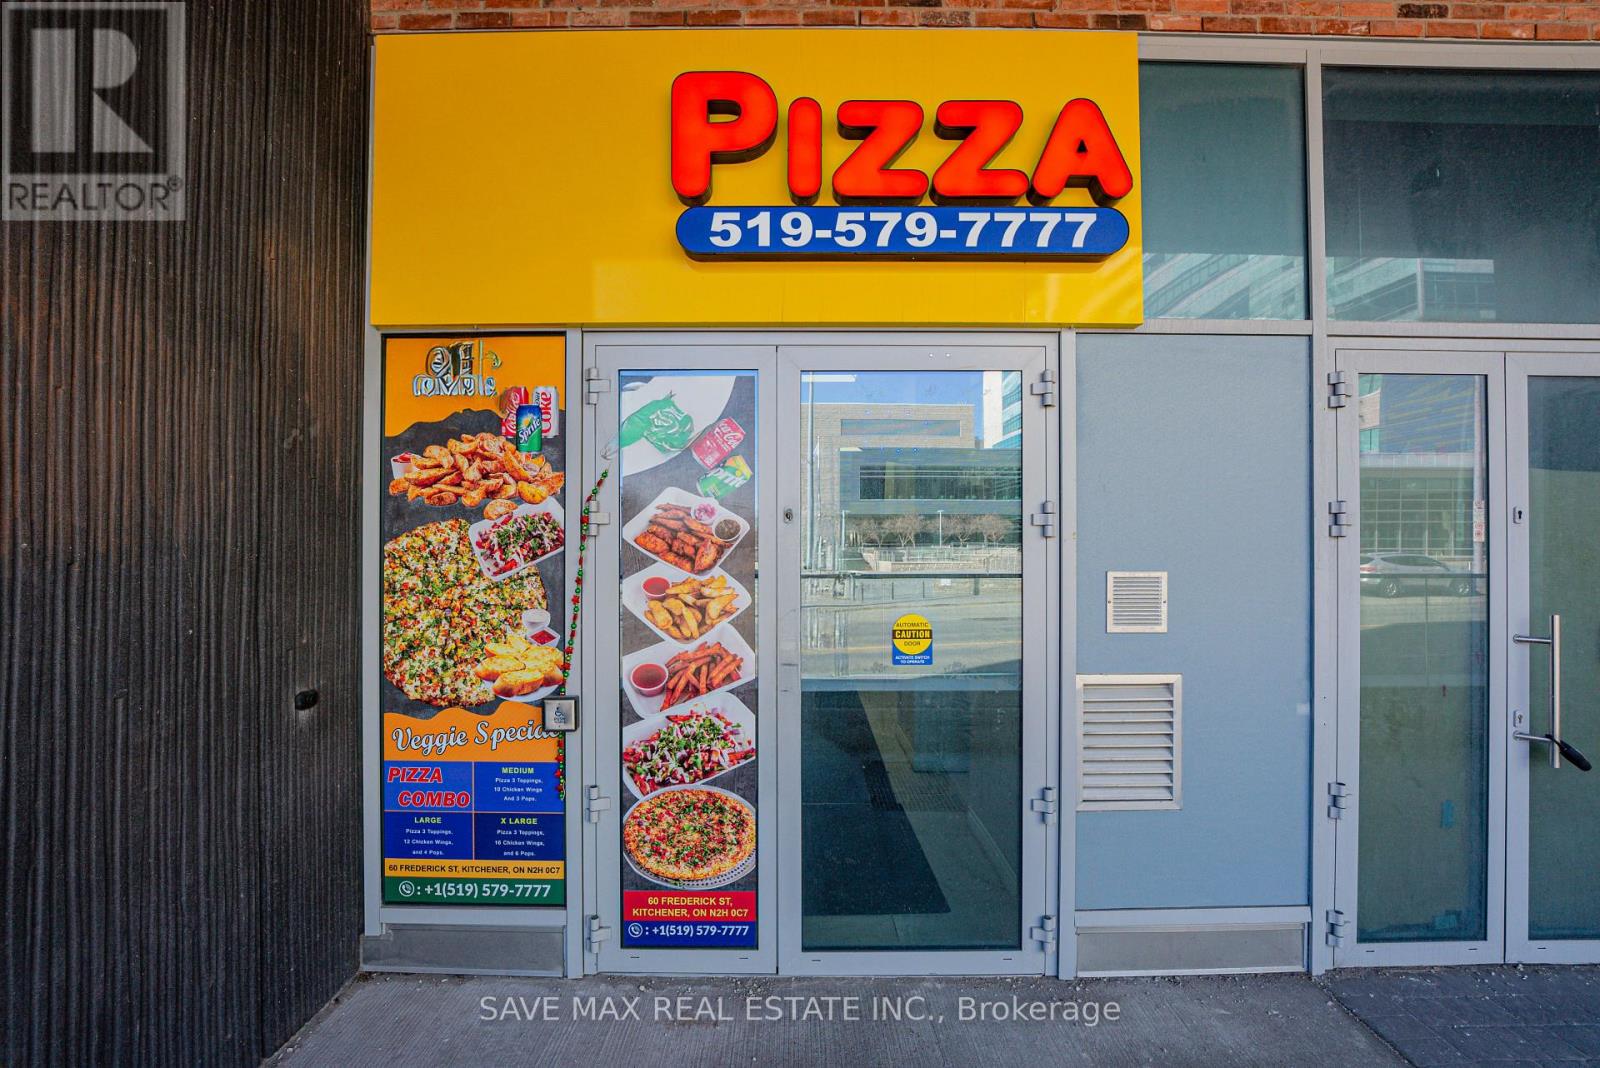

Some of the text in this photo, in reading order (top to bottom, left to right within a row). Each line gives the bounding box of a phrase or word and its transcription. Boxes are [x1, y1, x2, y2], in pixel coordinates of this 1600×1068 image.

[709, 212, 1097, 248] 519-579-7777
[518, 418, 541, 444] Sprite
[895, 630, 930, 639] CAUTION
[392, 721, 560, 757] Veggie Specia
[387, 766, 443, 783] PIZZA
[397, 790, 471, 808] COMBO
[414, 816, 442, 824] LARGE
[500, 817, 538, 825] X LARGE
[388, 864, 398, 872] 60
[400, 865, 446, 873] FREDERICK
[448, 866, 460, 874] ST,
[462, 866, 511, 875] KITCHENER,
[512, 866, 525, 874] ON
[424, 882, 479, 899] +1(519)
[482, 883, 551, 897] 579-7777
[647, 897, 733, 906] 60 FREDERICK ST,
[632, 908, 690, 918] KITCHENER,
[692, 908, 707, 918] ON
[710, 908, 729, 918] N2H
[652, 925, 694, 937] +1(519)
[696, 925, 750, 936] 579-7777
